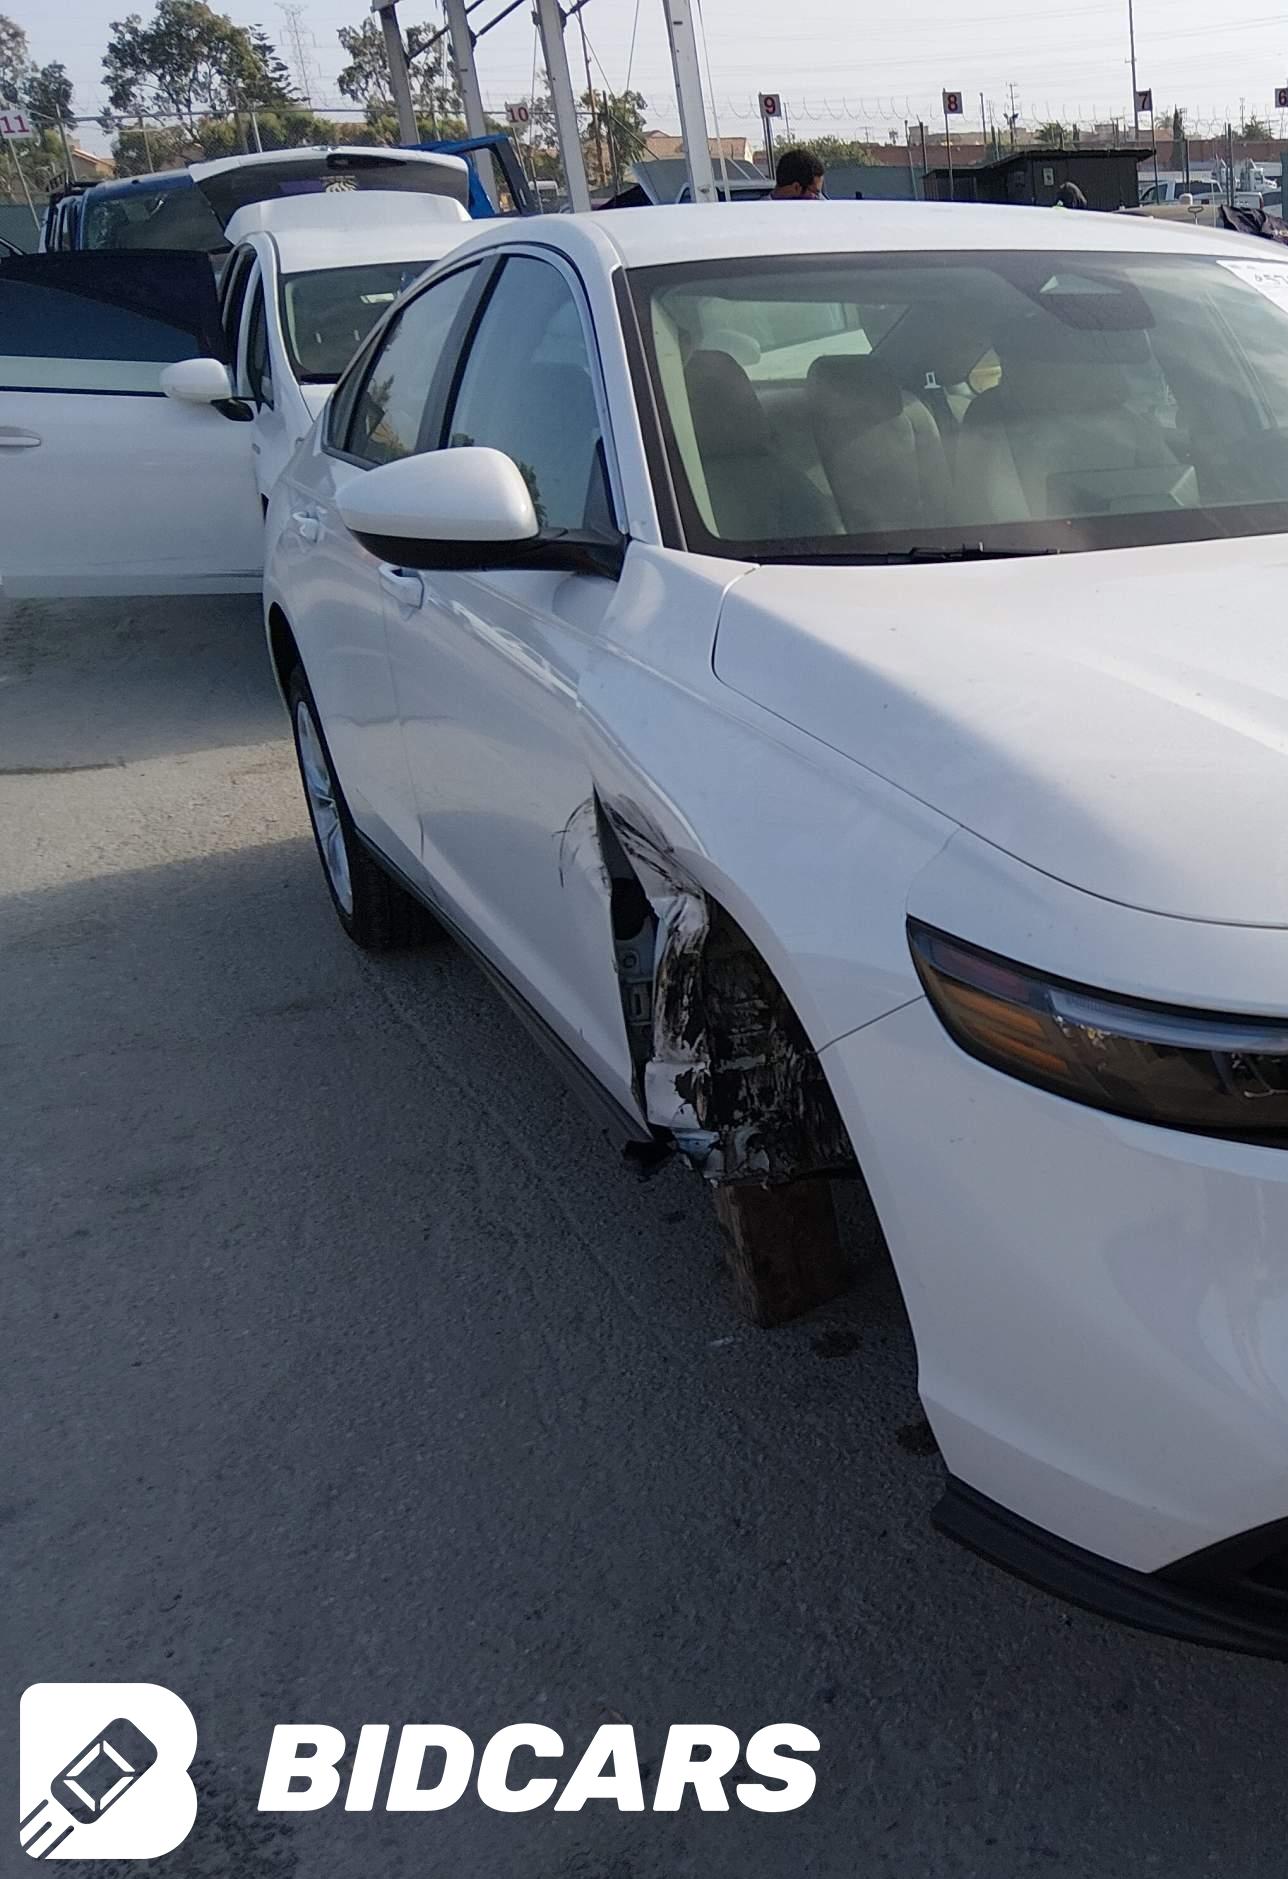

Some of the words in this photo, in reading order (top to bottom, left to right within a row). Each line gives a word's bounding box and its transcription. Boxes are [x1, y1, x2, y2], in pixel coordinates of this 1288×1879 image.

[763, 96, 776, 115] 9
[947, 94, 958, 112] 8
[1138, 91, 1148, 110] 7
[1279, 89, 1287, 106] 6
[506, 106, 529, 123] 10
[0, 114, 30, 134] 11
